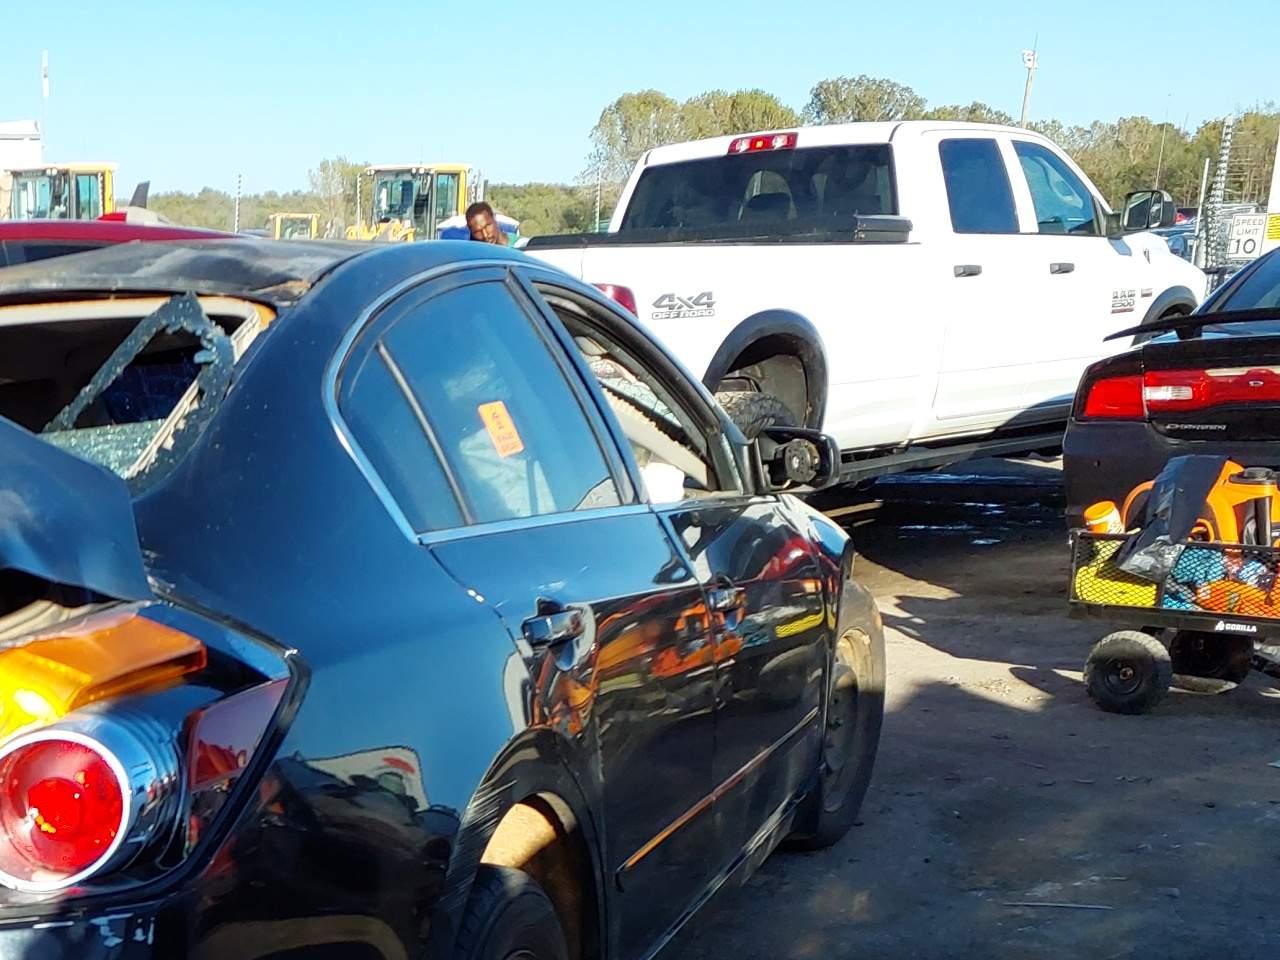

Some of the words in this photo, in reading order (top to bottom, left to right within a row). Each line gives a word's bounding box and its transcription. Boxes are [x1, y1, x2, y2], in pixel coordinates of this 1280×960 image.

[1236, 228, 1260, 236] LIMIT
[1234, 238, 1257, 254] 10
[1225, 623, 1257, 632] GORILLA
